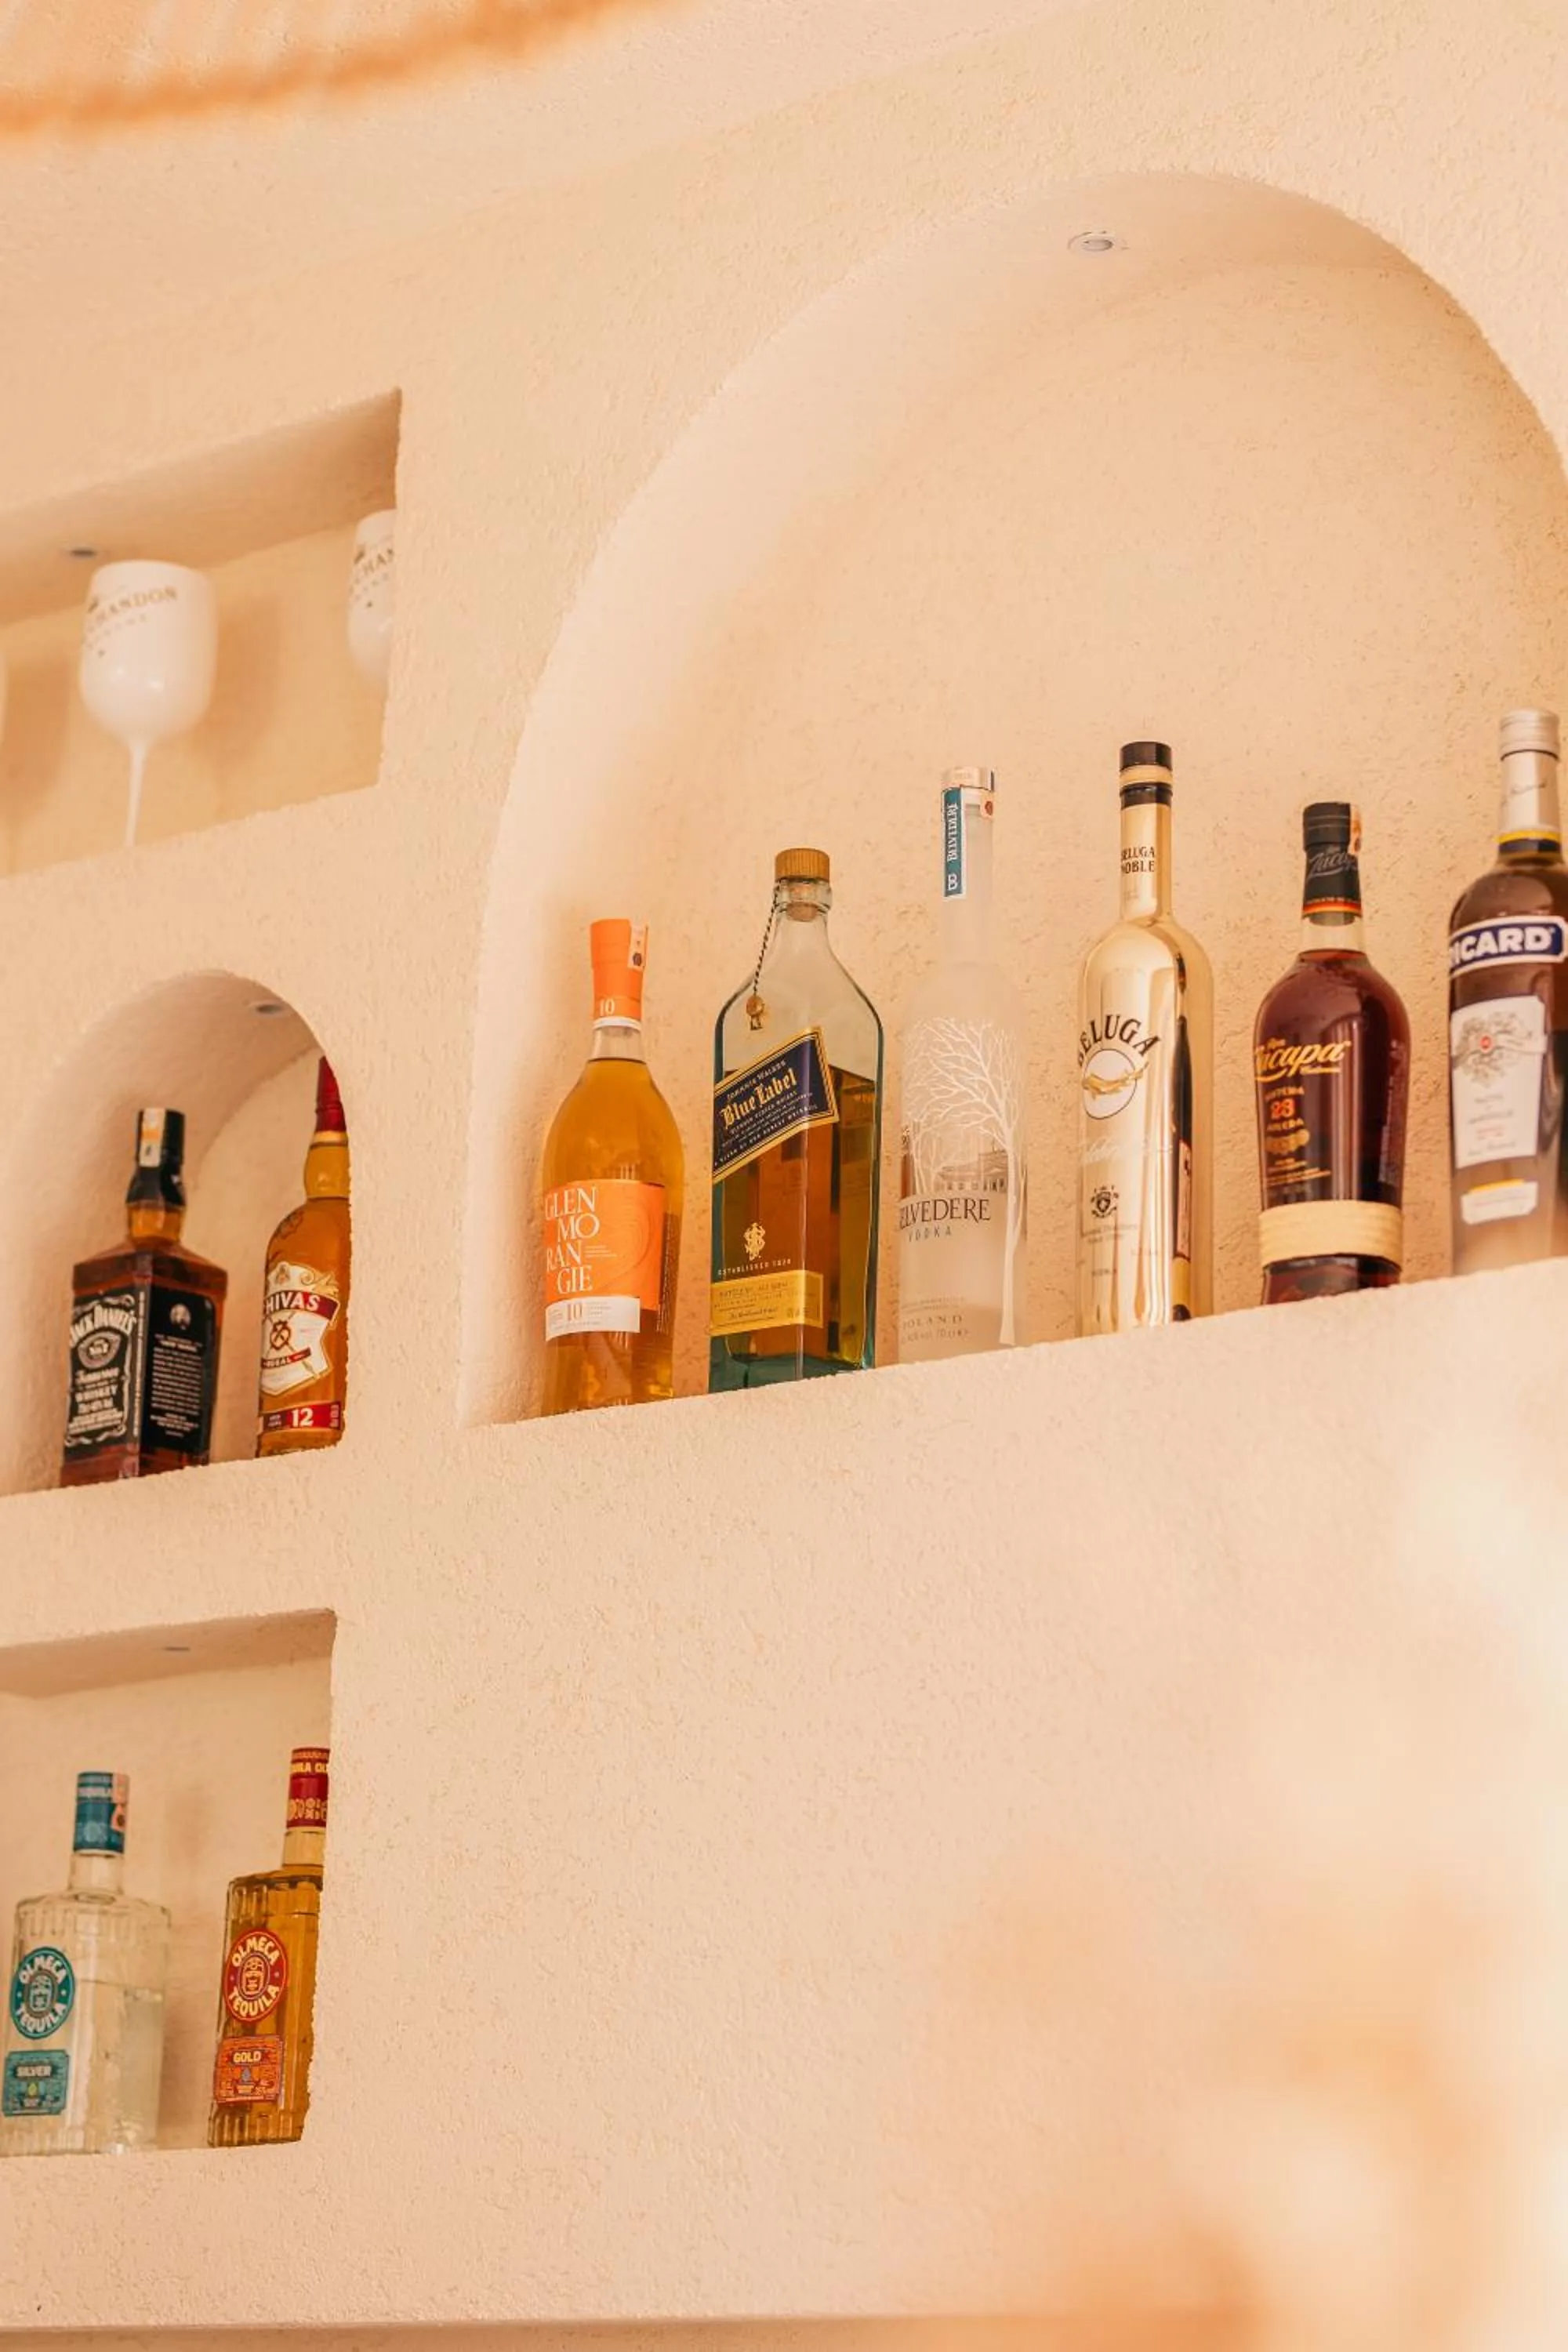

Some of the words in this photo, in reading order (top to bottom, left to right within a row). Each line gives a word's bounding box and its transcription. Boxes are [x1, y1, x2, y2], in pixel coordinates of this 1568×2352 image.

[1450, 926, 1552, 967] ICARD
[720, 1096, 755, 1130] Blue
[754, 1067, 797, 1109] Label
[546, 1186, 597, 1221] GLEN
[899, 1197, 991, 1230] ELVEDERE
[557, 1213, 600, 1242] MO
[546, 1240, 583, 1272] RAN
[557, 1265, 593, 1294] GIE
[265, 1291, 320, 1313] HIVAS
[292, 1407, 314, 1428] 12
[231, 1936, 280, 1967] OLMECA
[19, 1955, 67, 1985] OLMECA
[228, 1985, 280, 2017] TEQUILA
[16, 2002, 67, 2033] TEQUILA
[234, 2051, 261, 2063] GOLD
